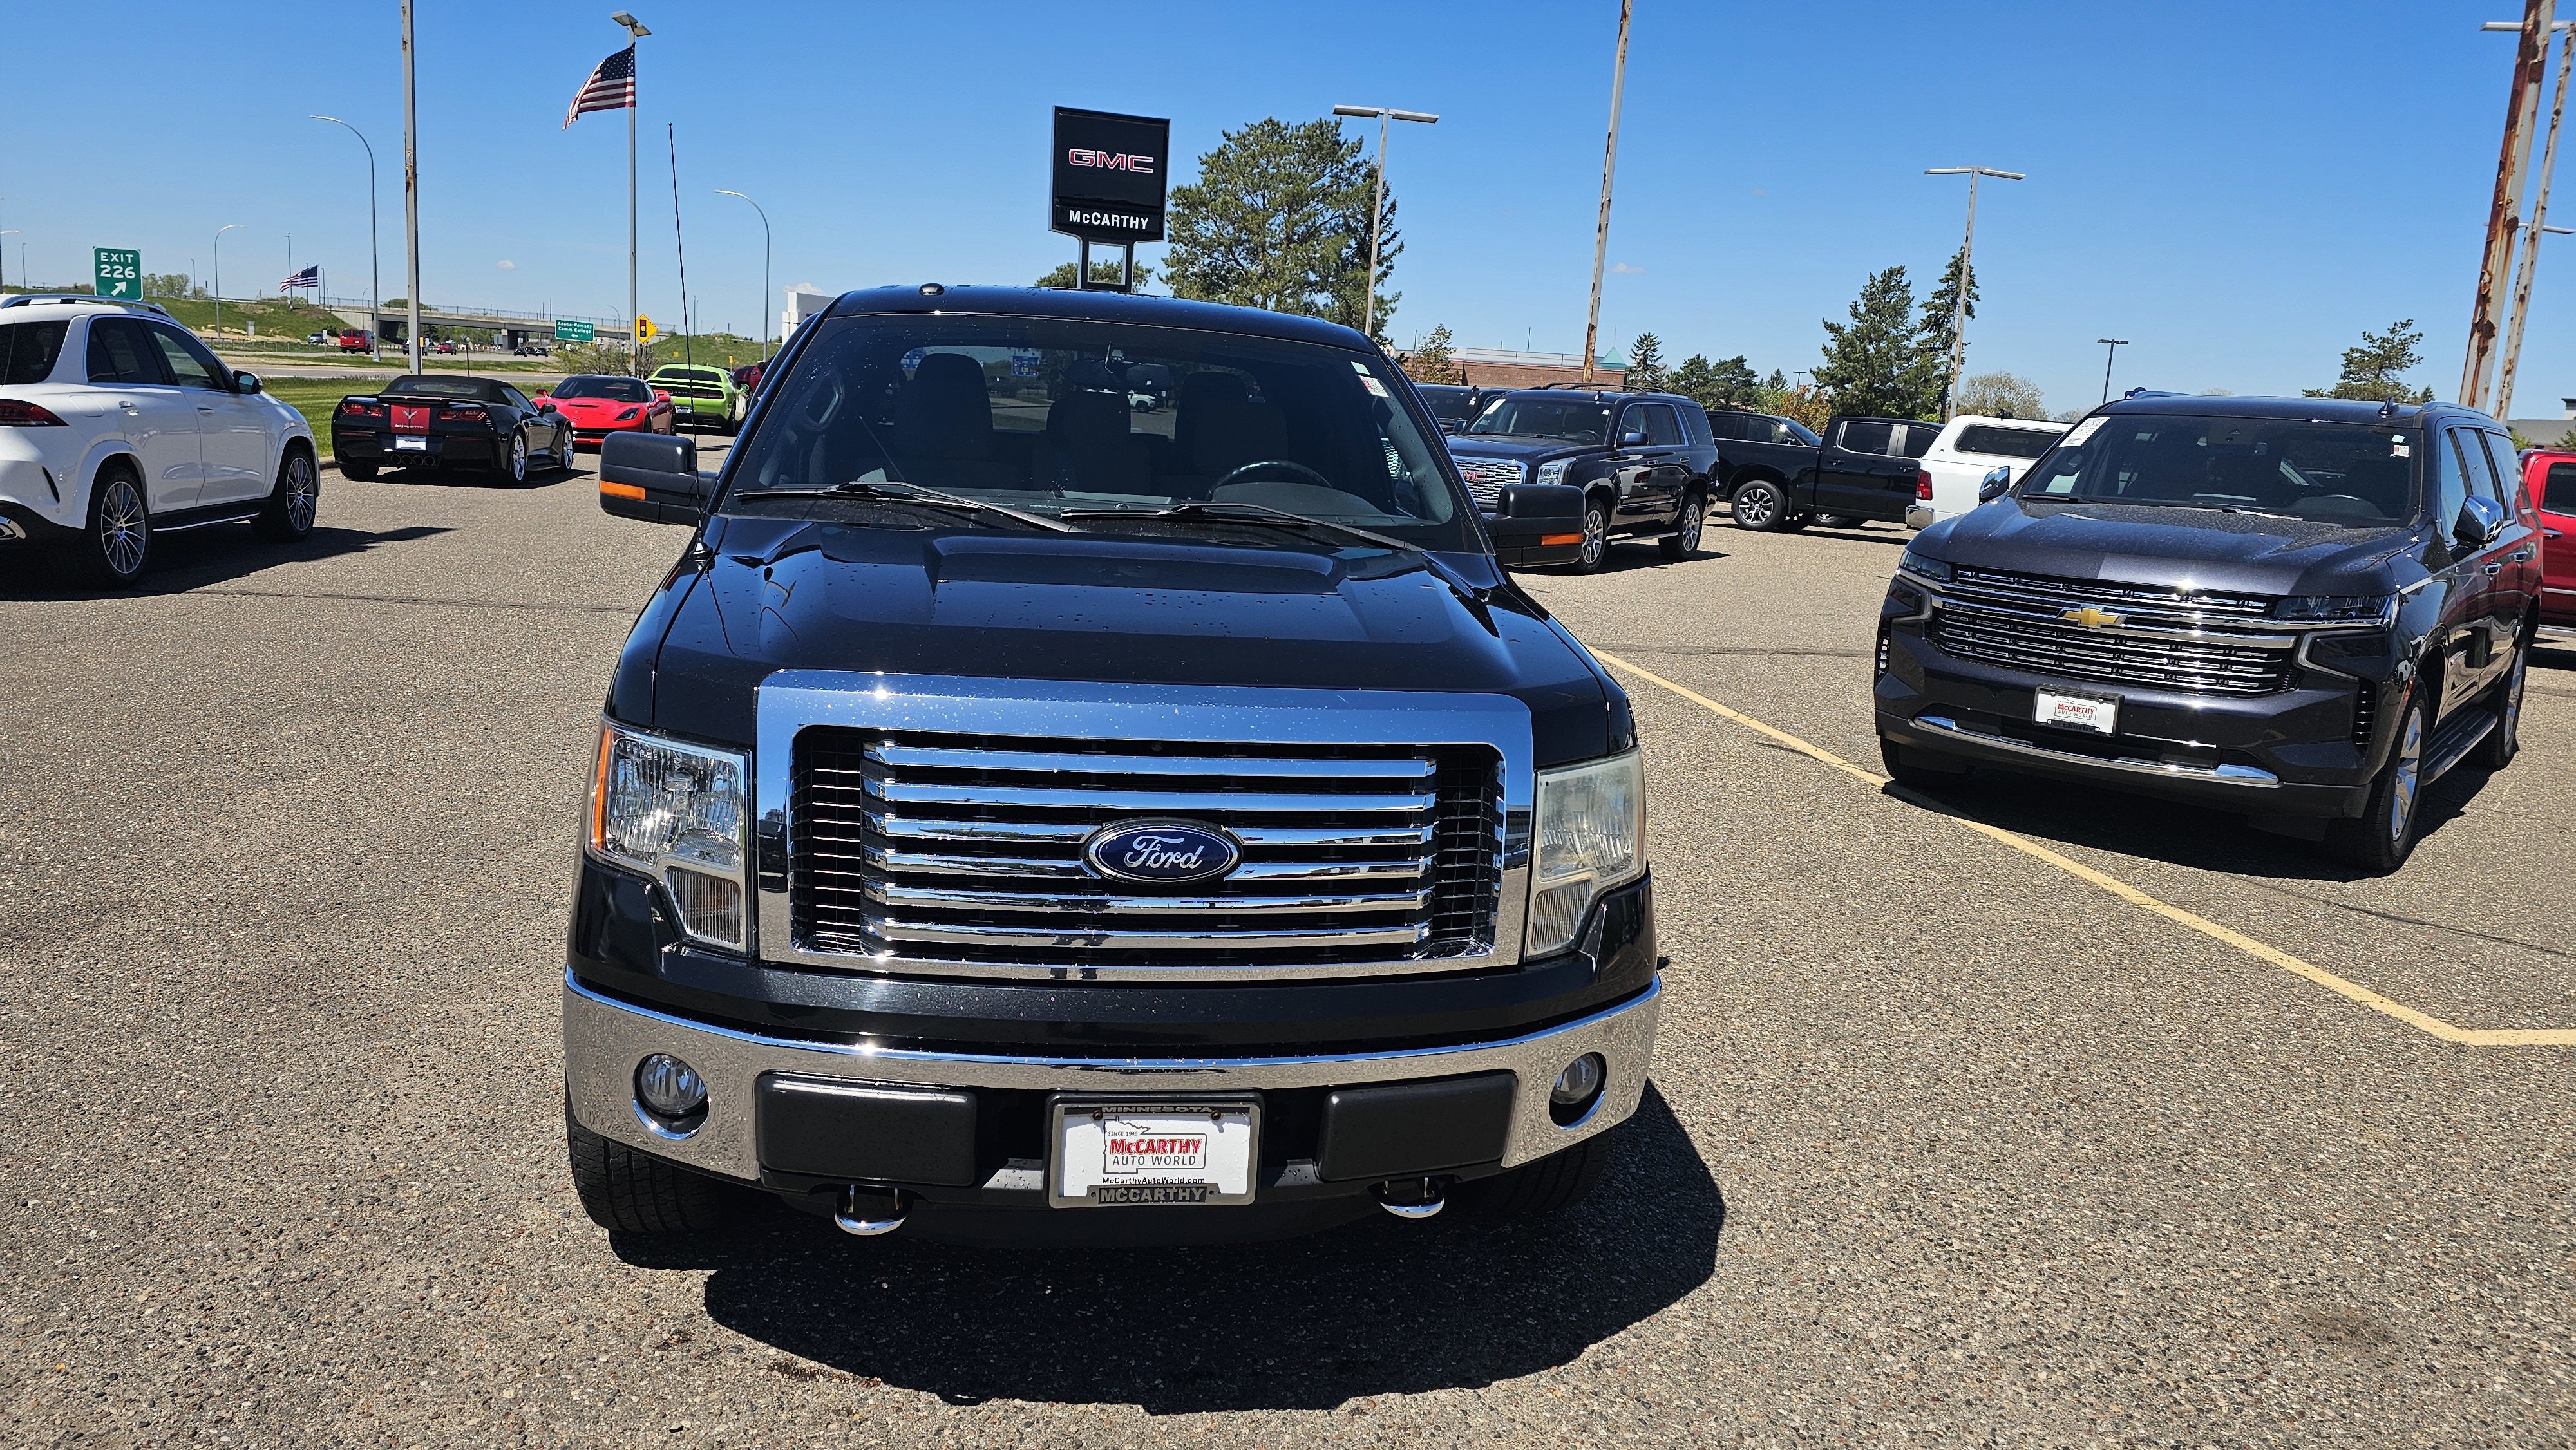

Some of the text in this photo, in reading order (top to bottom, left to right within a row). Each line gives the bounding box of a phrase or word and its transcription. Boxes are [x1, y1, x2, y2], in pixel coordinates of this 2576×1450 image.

[1068, 148, 1154, 174] GMC
[1068, 210, 1149, 230] McCARTHY
[100, 252, 134, 263] EXIT
[100, 264, 136, 279] 226
[1463, 471, 1487, 482] MC
[2058, 704, 2095, 715] McCARTHY
[1124, 835, 1204, 869] Ford
[1110, 1138, 1202, 1155] McCARTHY
[1112, 1156, 1197, 1165] AUTO WORLD
[1100, 1187, 1205, 1202] MCCARTHY
